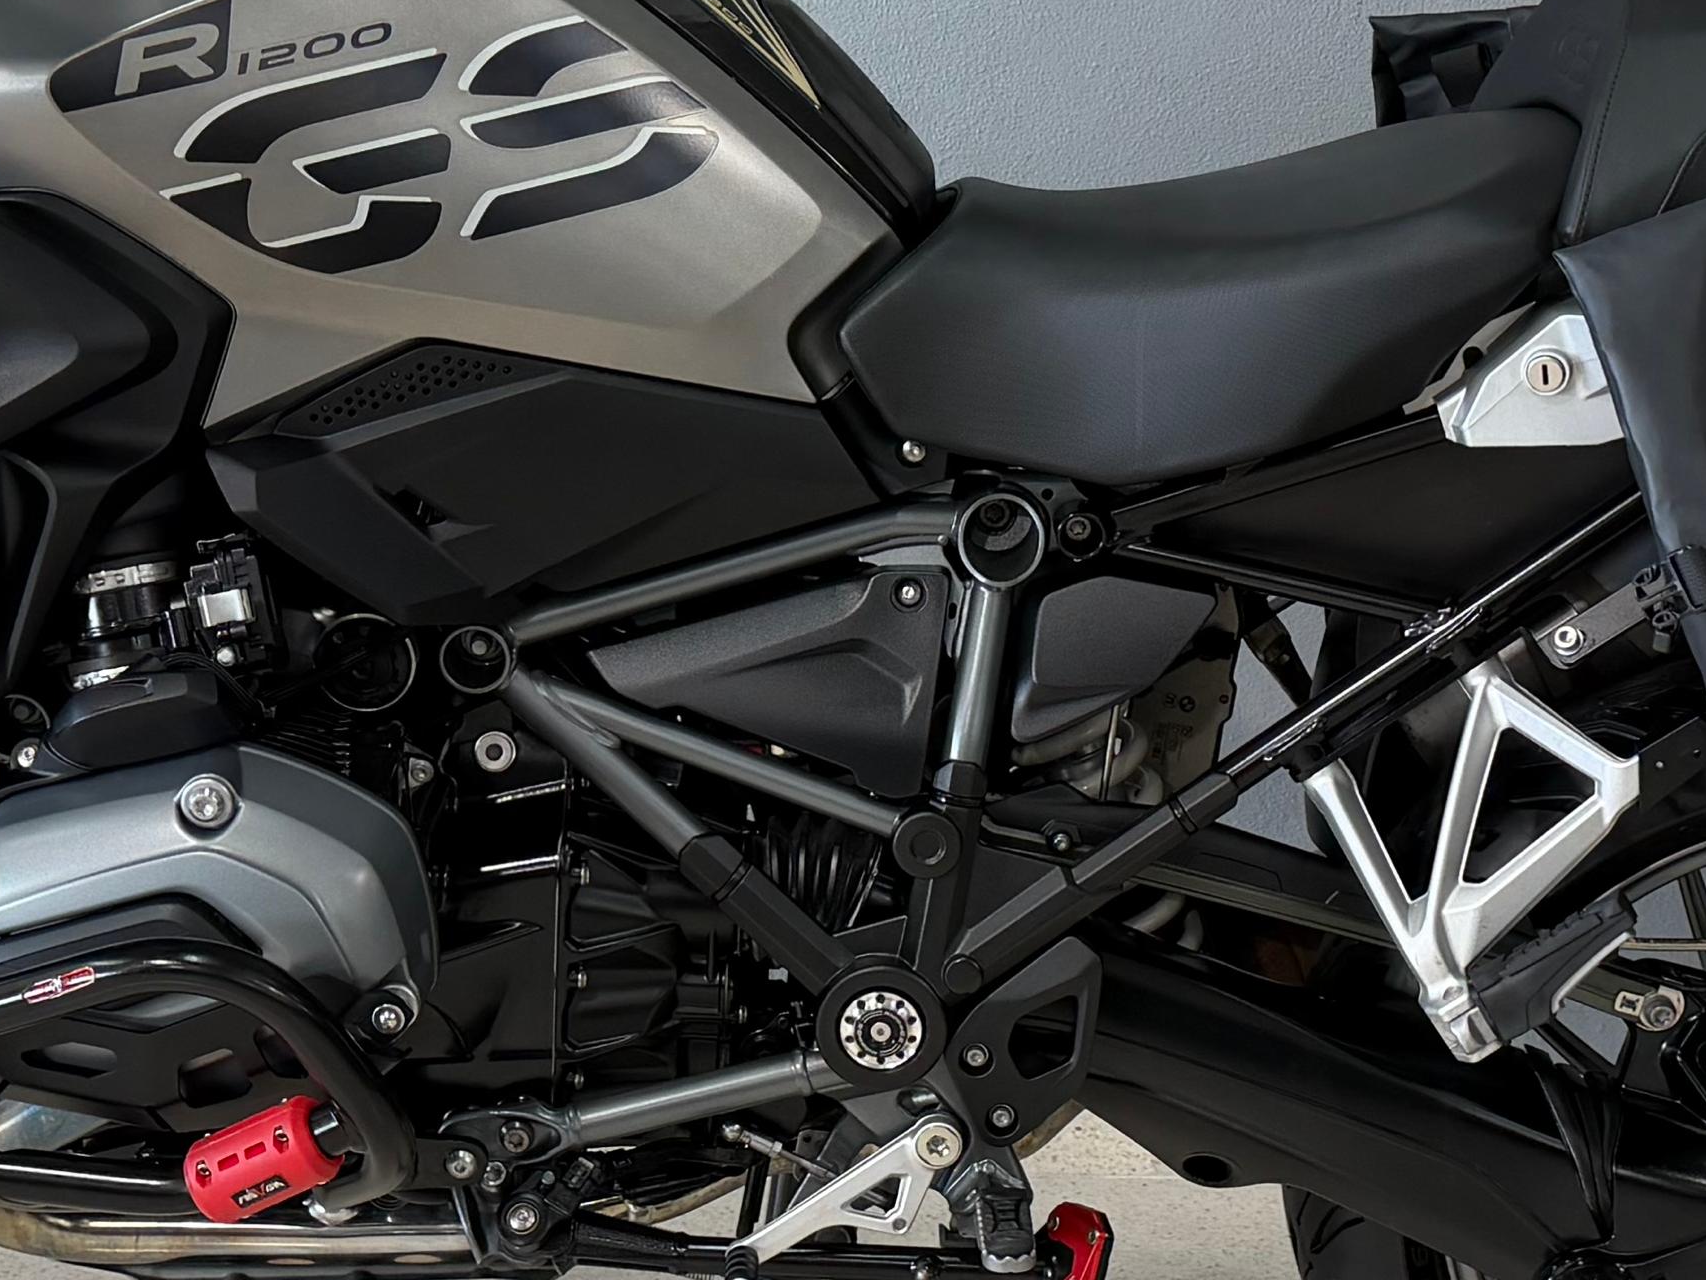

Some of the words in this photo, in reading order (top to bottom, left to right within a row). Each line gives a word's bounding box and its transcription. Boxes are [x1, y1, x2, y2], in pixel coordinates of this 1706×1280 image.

[115, 23, 219, 97] R
[238, 22, 392, 75] 1200
[159, 15, 719, 275] GS
